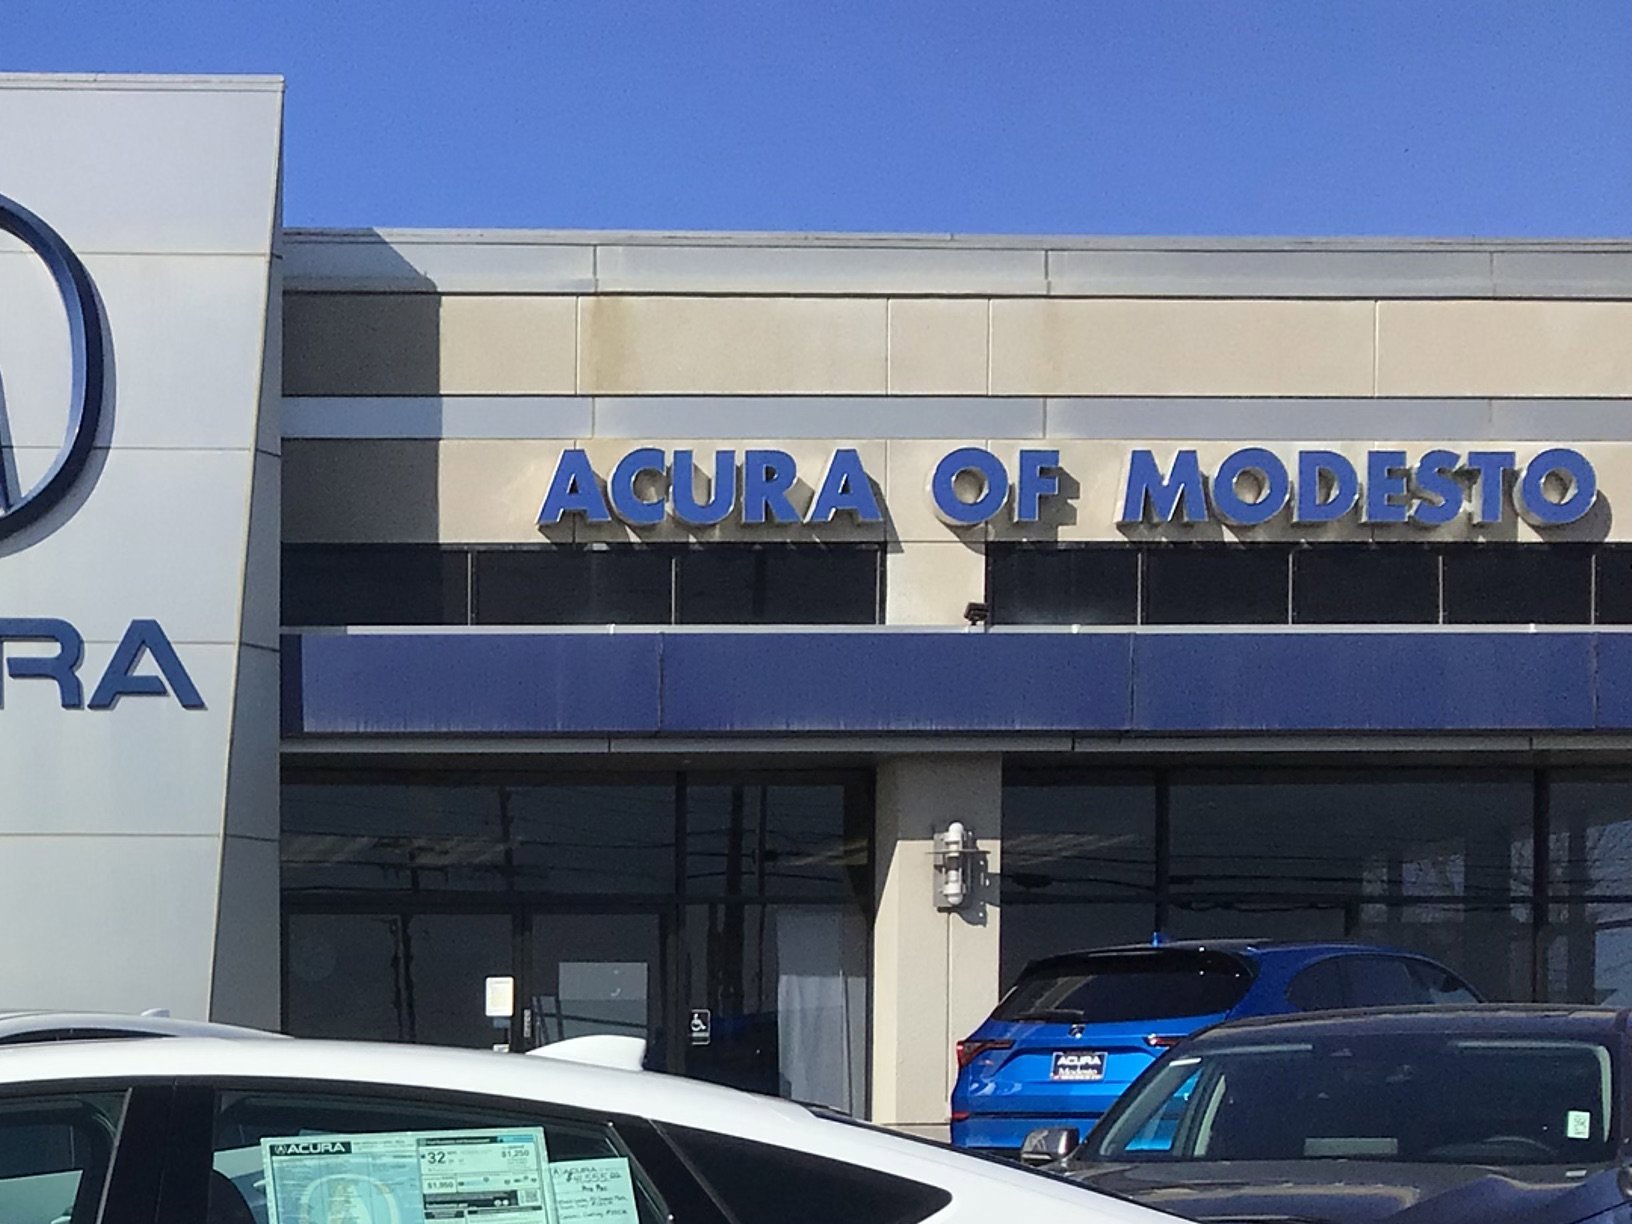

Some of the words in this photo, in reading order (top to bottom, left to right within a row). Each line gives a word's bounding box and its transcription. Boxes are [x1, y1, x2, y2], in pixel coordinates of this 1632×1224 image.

[536, 446, 884, 526] ACURA
[929, 446, 1061, 526] OF
[1117, 446, 1598, 526] MODESTO
[1057, 1056, 1101, 1065] ACURA
[287, 1142, 346, 1154] ACURA
[427, 1150, 446, 1164] 32
